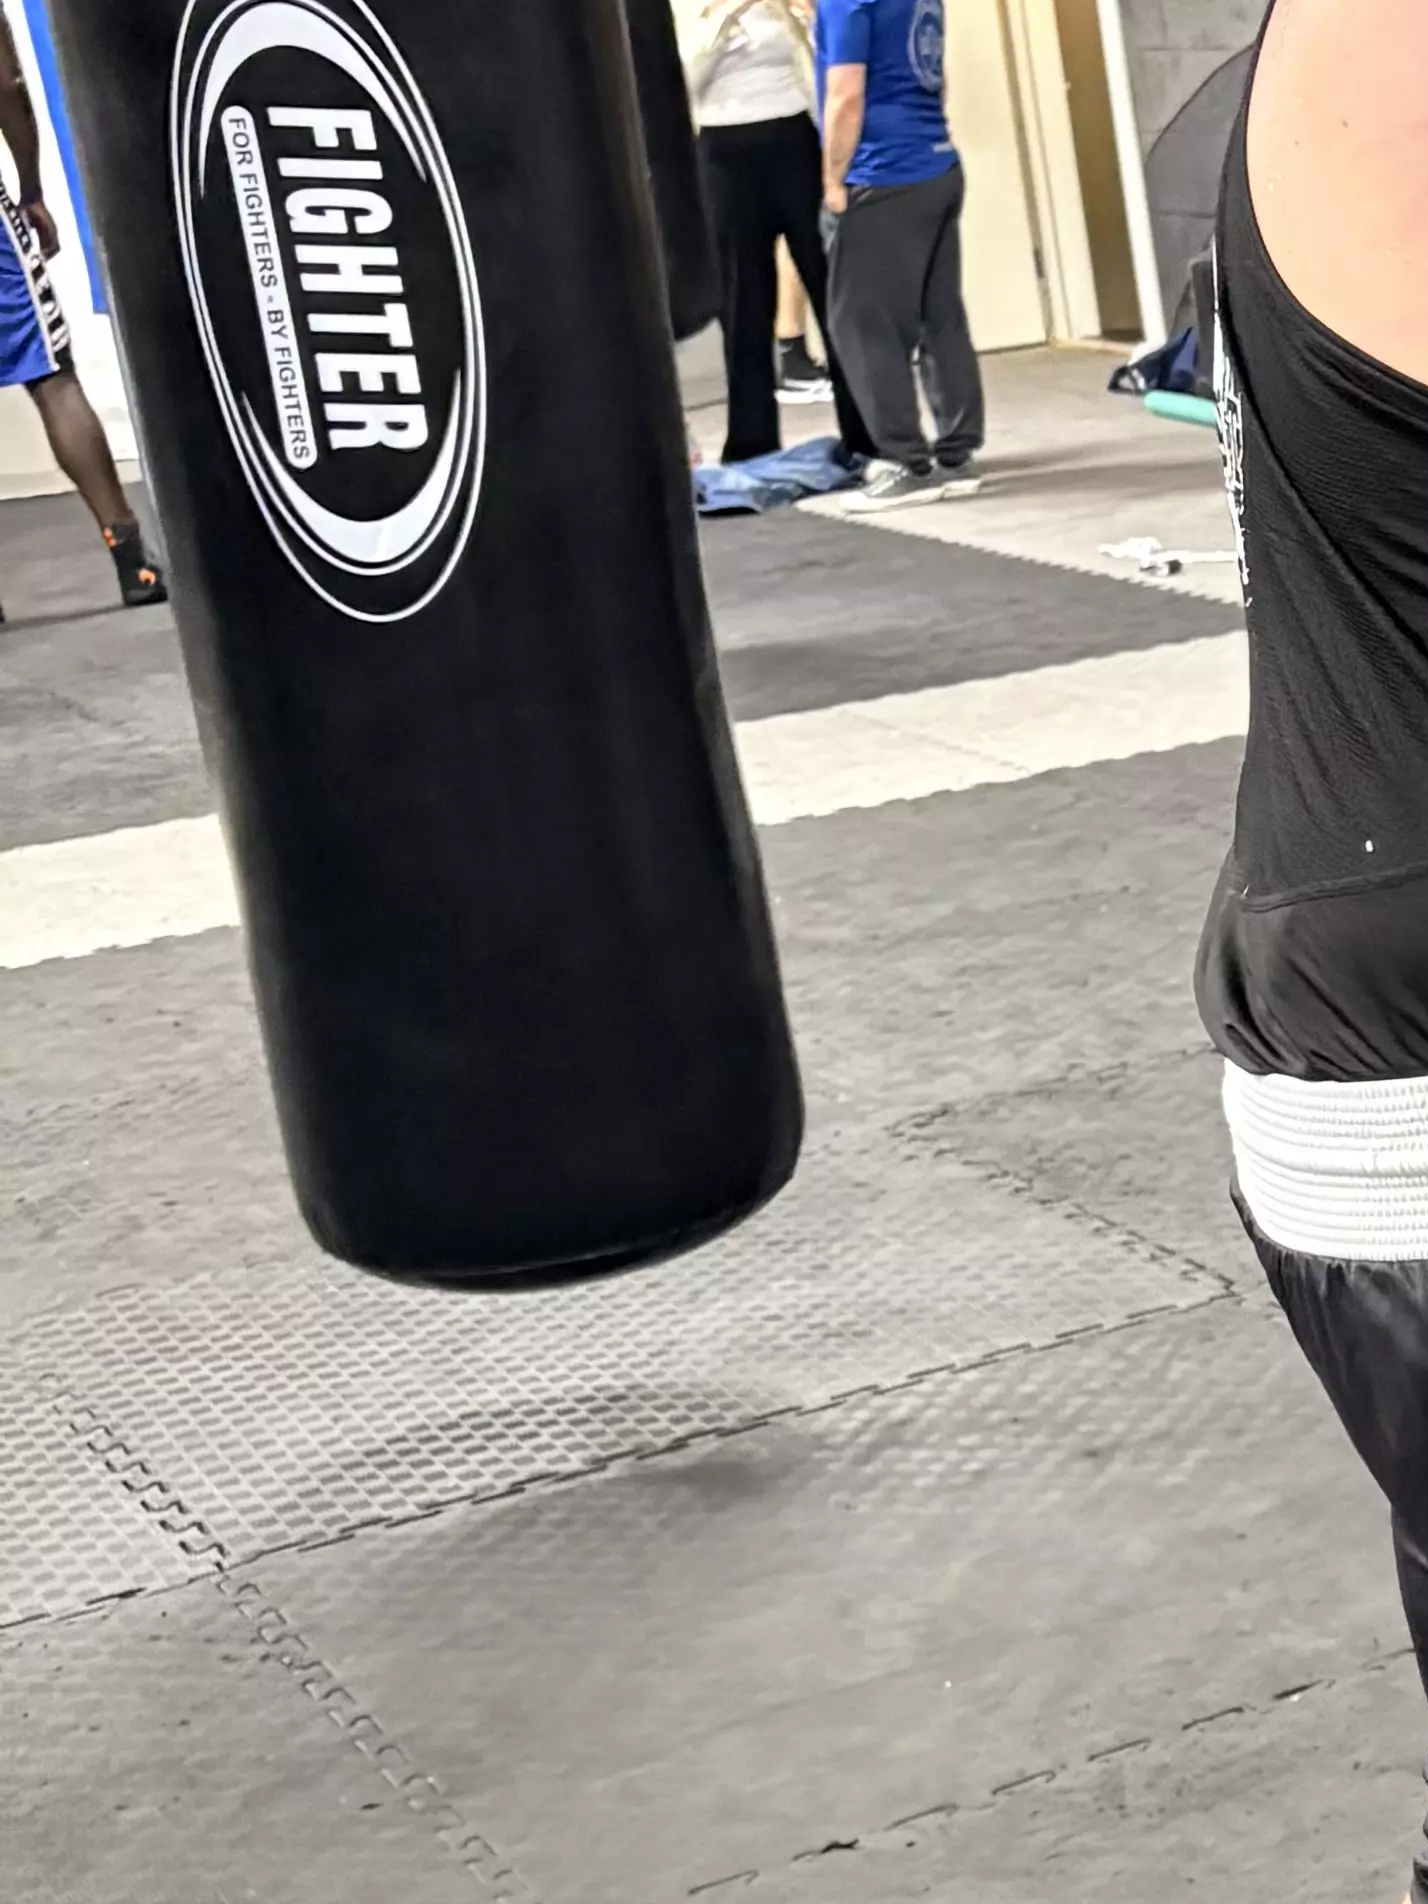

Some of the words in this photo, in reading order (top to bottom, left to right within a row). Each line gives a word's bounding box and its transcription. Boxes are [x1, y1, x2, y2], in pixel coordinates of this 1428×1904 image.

[228, 117, 254, 166] FOR
[239, 173, 278, 288] FIGHTERS
[266, 106, 429, 450] FIGHTER
[267, 309, 289, 339] BY
[274, 346, 310, 459] FIGHTERS
